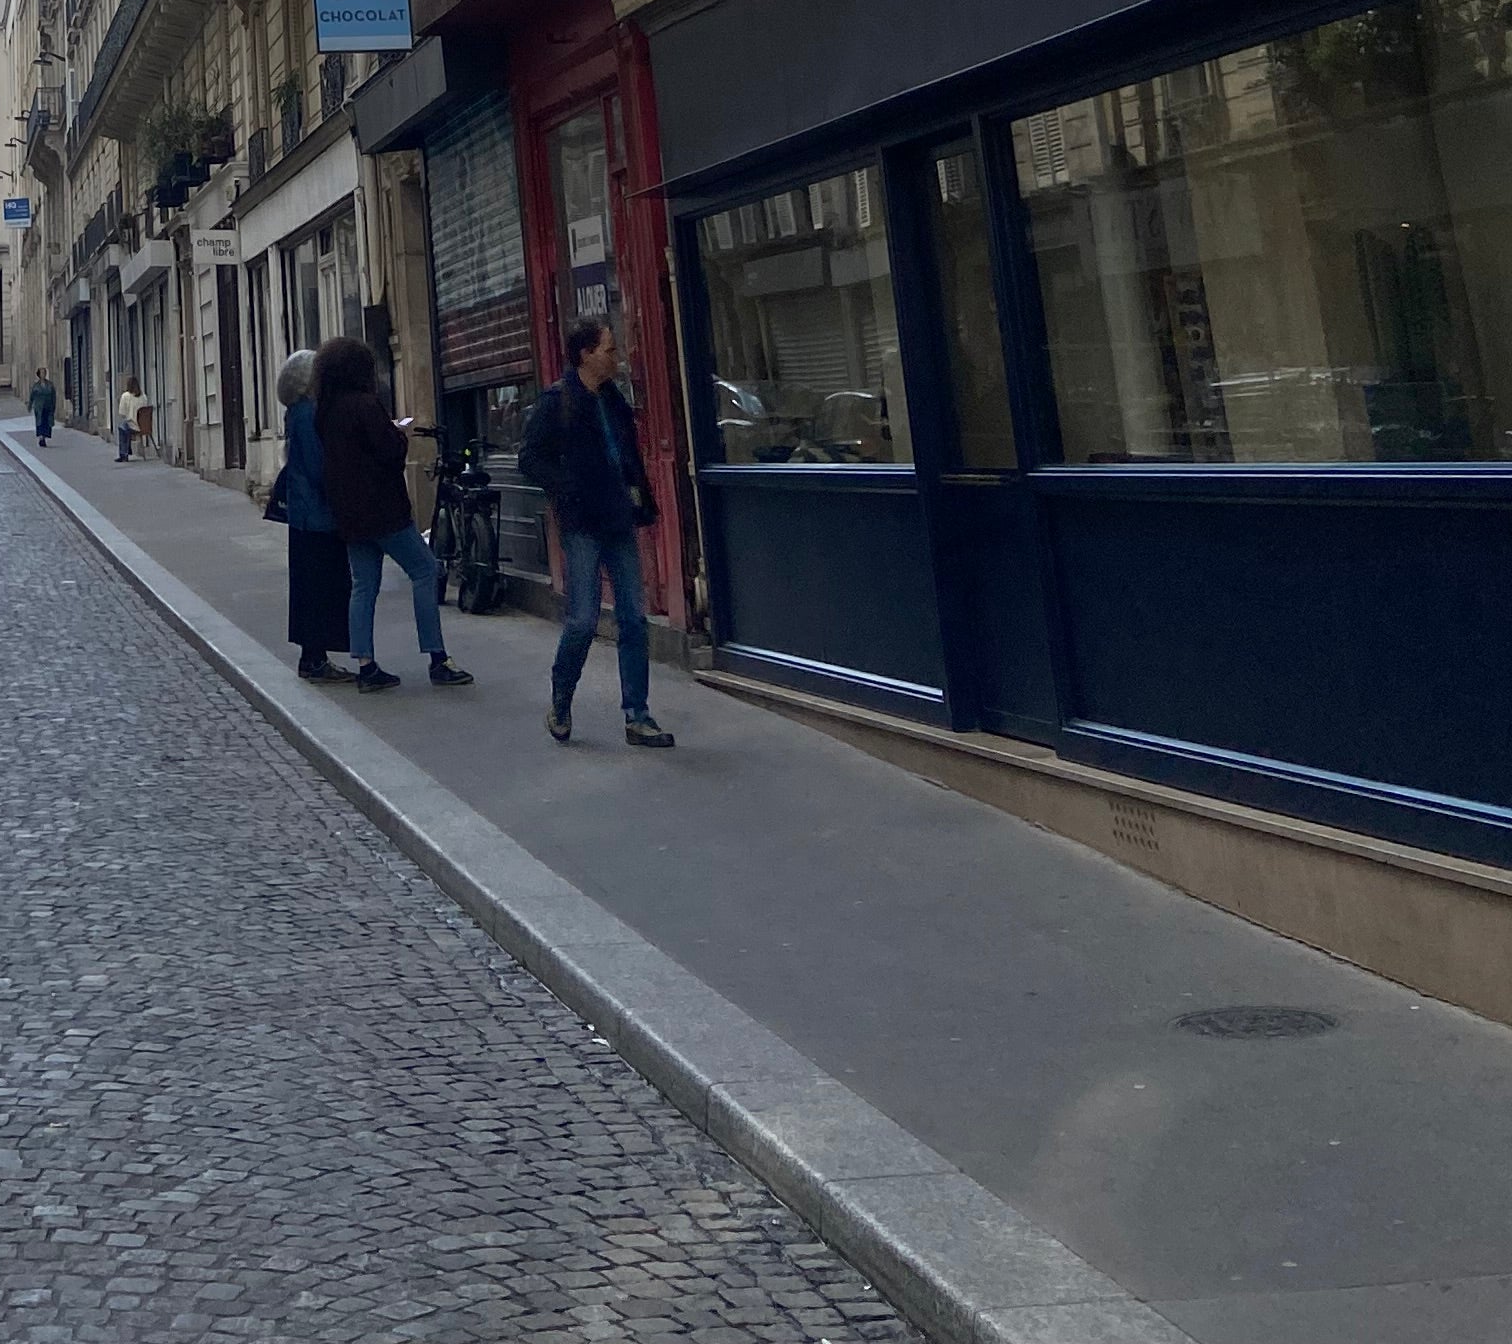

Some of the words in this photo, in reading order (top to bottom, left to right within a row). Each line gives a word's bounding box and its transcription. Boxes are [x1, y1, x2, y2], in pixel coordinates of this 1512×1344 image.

[320, 9, 405, 23] CHOCOLAT
[197, 237, 231, 248] champ
[213, 247, 235, 257] libre
